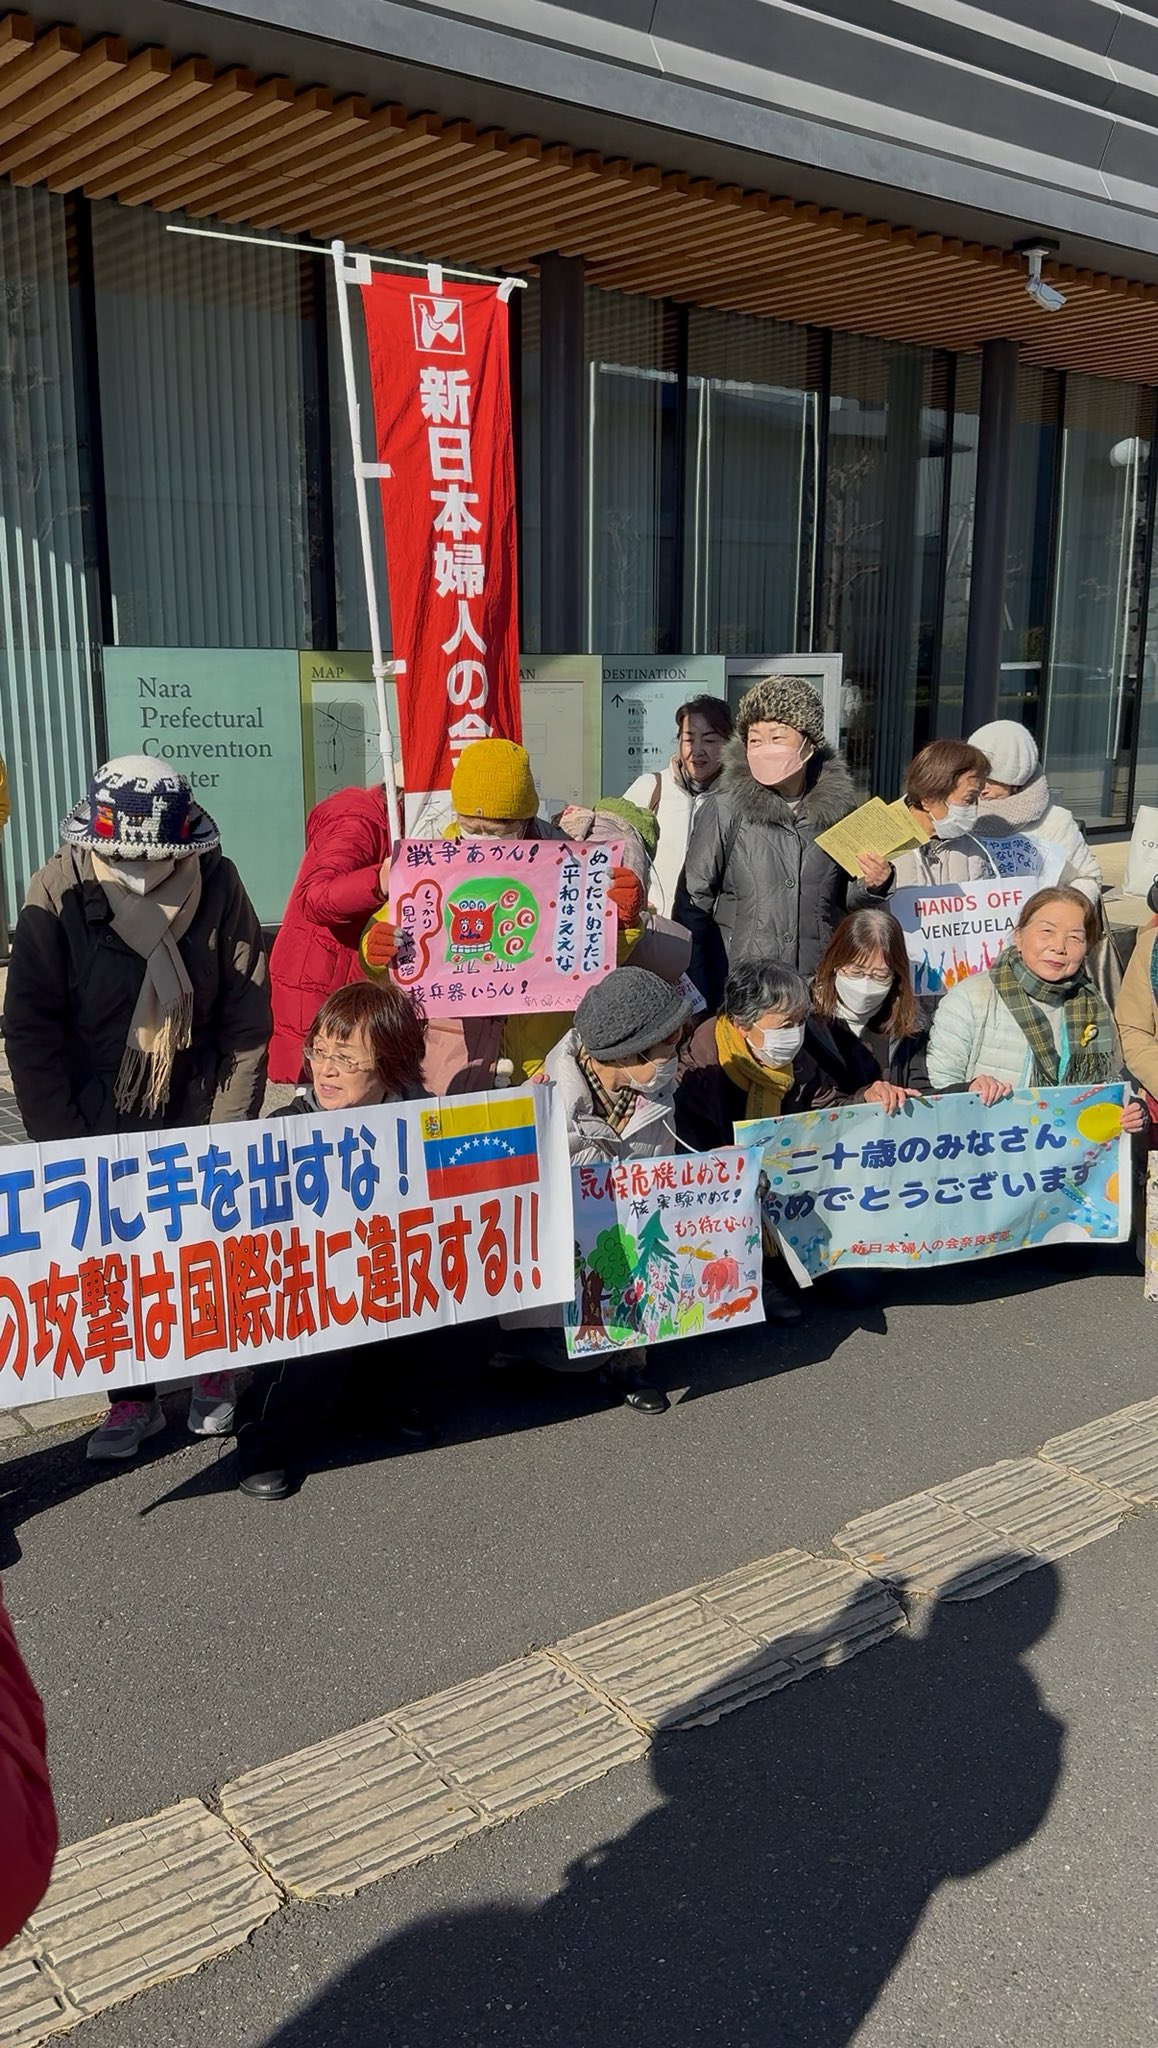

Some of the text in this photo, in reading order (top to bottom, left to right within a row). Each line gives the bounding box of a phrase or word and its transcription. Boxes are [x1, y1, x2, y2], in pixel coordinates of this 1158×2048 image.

[419, 366, 493, 768] 新日本婦人の会
[312, 666, 344, 679] MAP
[519, 669, 536, 680] AN
[603, 669, 687, 679] DESTINATION
[137, 677, 192, 698] Nara
[140, 706, 264, 729] Prefectural
[142, 738, 273, 759] Convention
[407, 841, 539, 867] 戦争あかん！
[422, 890, 434, 929] しっかり
[914, 890, 1023, 918] HANDS OFF
[556, 864, 580, 972] 平和はええな
[920, 916, 1015, 940] VENEZUELA
[787, 1123, 1068, 1176] 二十歳のみなさん
[0, 1118, 409, 1257] エラに手を出すな！
[580, 1157, 745, 1202] 気候危機止めて！
